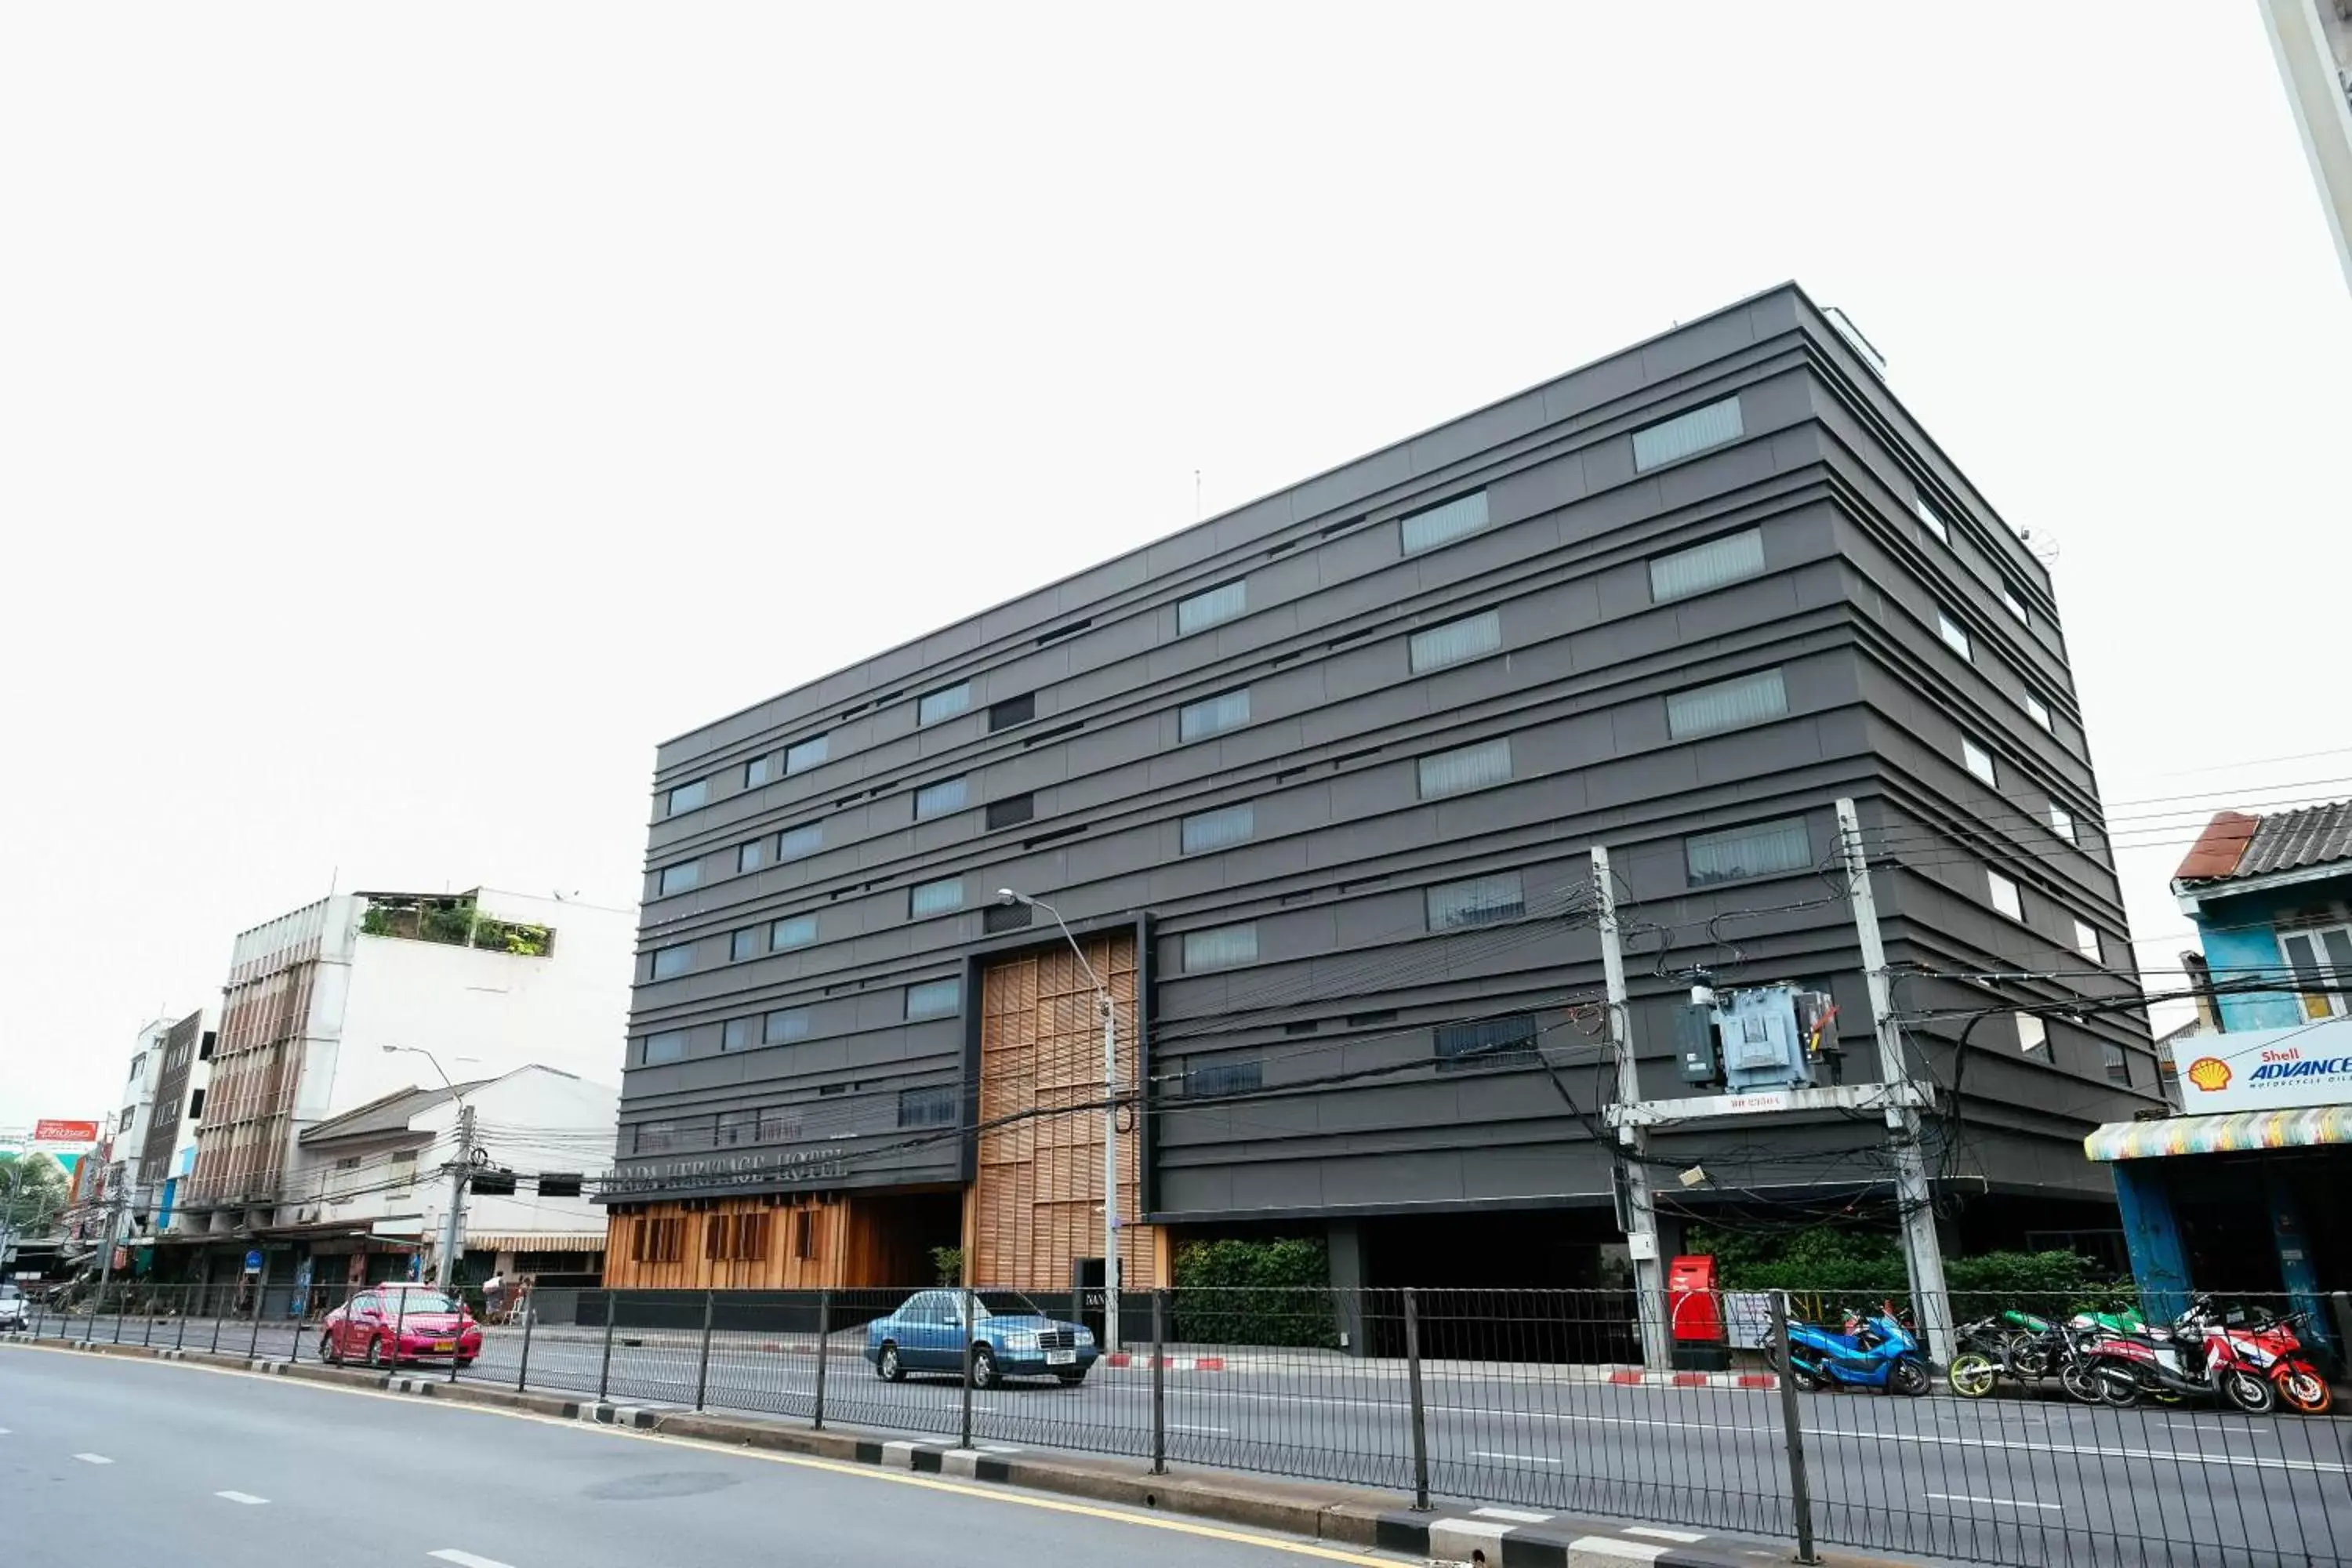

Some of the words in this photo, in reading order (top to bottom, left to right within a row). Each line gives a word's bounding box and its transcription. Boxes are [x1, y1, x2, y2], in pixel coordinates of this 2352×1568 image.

[2262, 1047, 2299, 1062] Shell
[2249, 1056, 2352, 1081] ADVANCE
[776, 1149, 848, 1181] HOTEL
